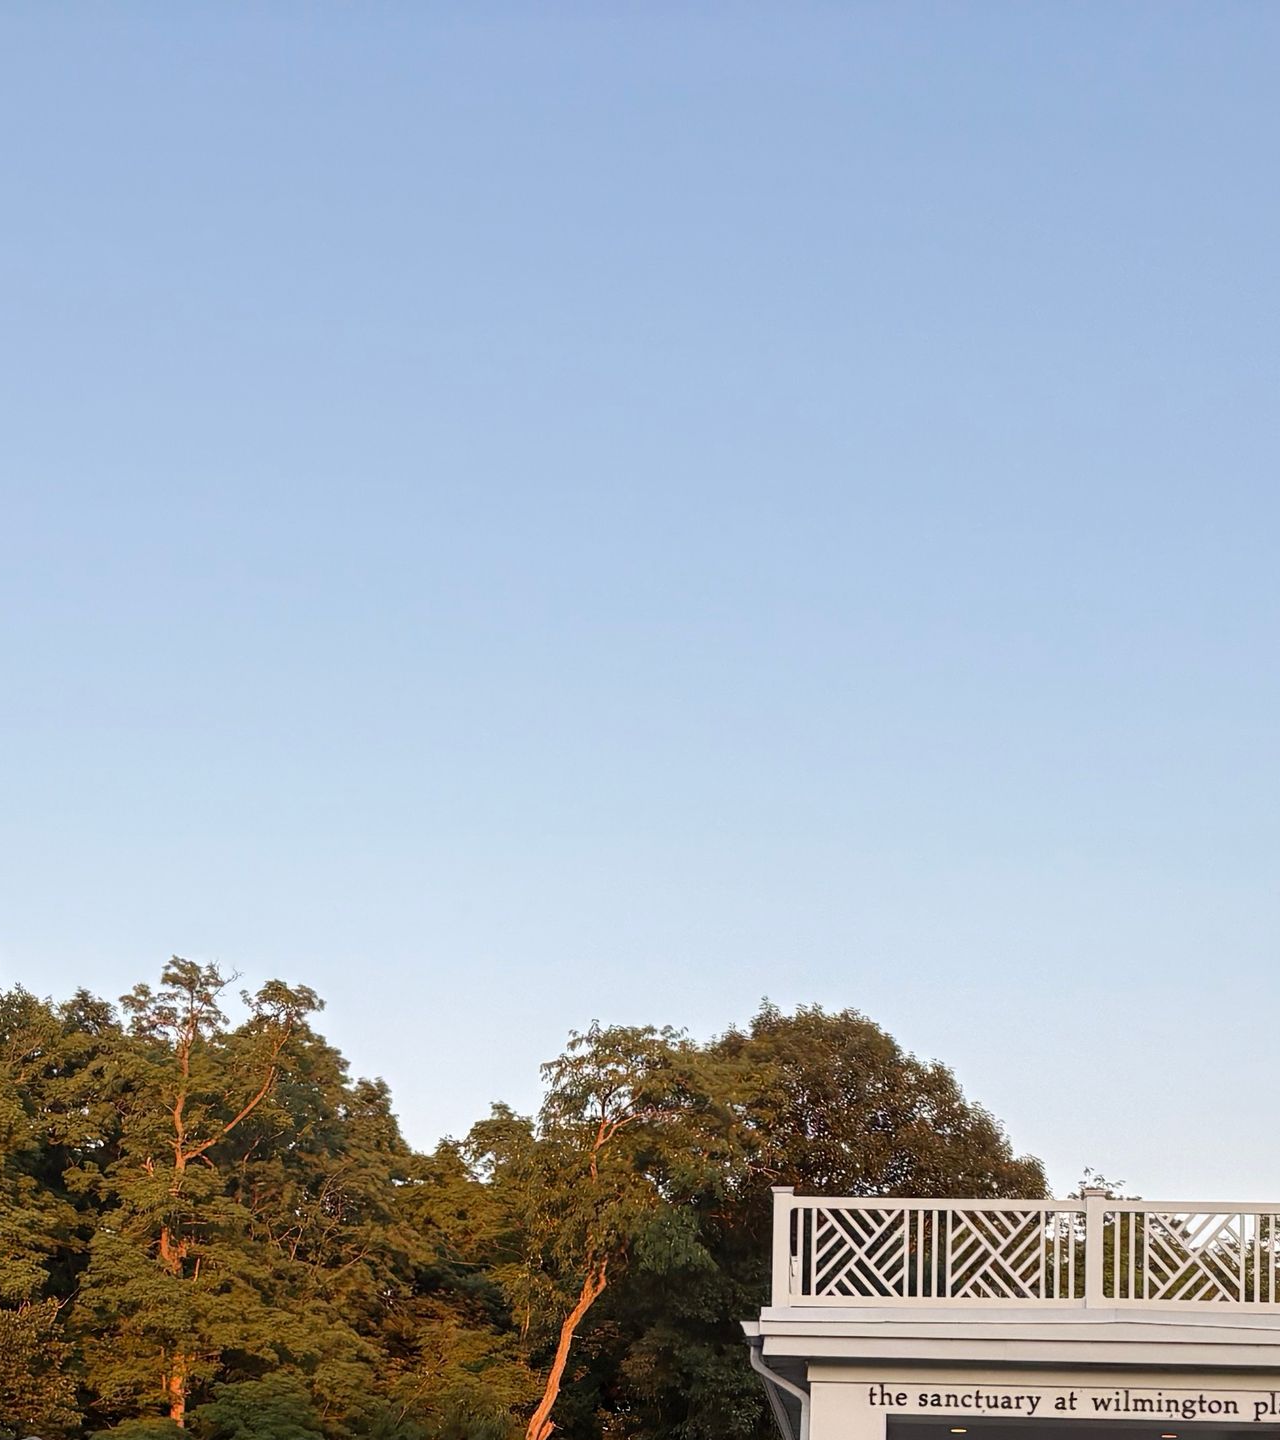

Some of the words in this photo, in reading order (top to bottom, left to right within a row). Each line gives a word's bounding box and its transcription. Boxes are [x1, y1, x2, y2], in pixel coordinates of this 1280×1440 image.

[868, 1383, 908, 1406] the
[918, 1389, 1042, 1416] sanctuary
[1054, 1391, 1078, 1411] at
[1091, 1389, 1240, 1419] wilmington
